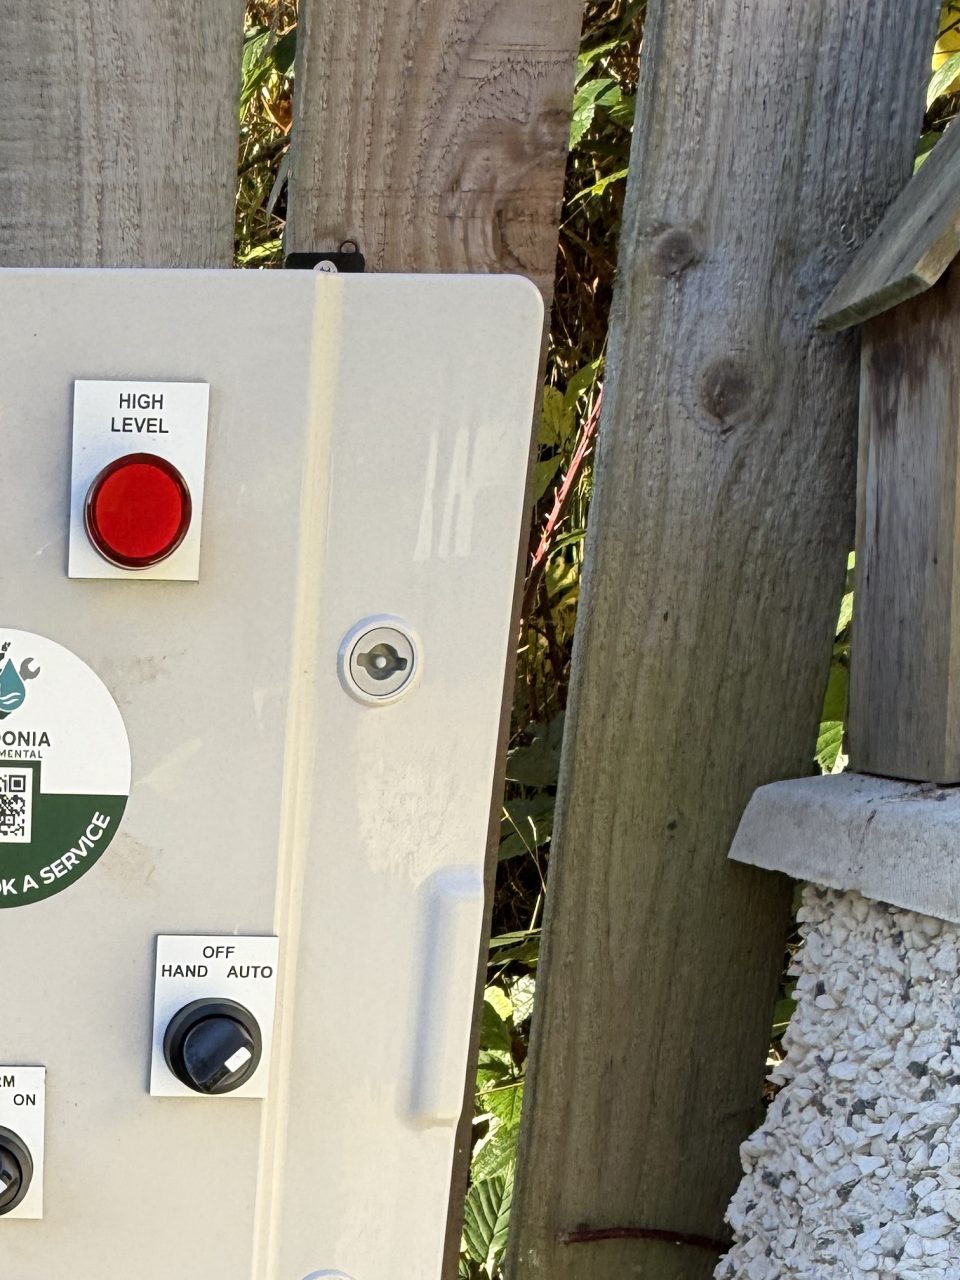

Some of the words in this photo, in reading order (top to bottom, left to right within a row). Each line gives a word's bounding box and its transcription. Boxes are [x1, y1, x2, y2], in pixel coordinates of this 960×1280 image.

[119, 393, 164, 410] HIGH
[110, 416, 169, 434] LEVEL
[22, 874, 39, 893] A
[40, 811, 111, 885] SERVICE
[202, 946, 235, 959] OFF
[161, 964, 208, 978] HAND
[226, 965, 273, 979] AUTO
[13, 1093, 36, 1106] ON
